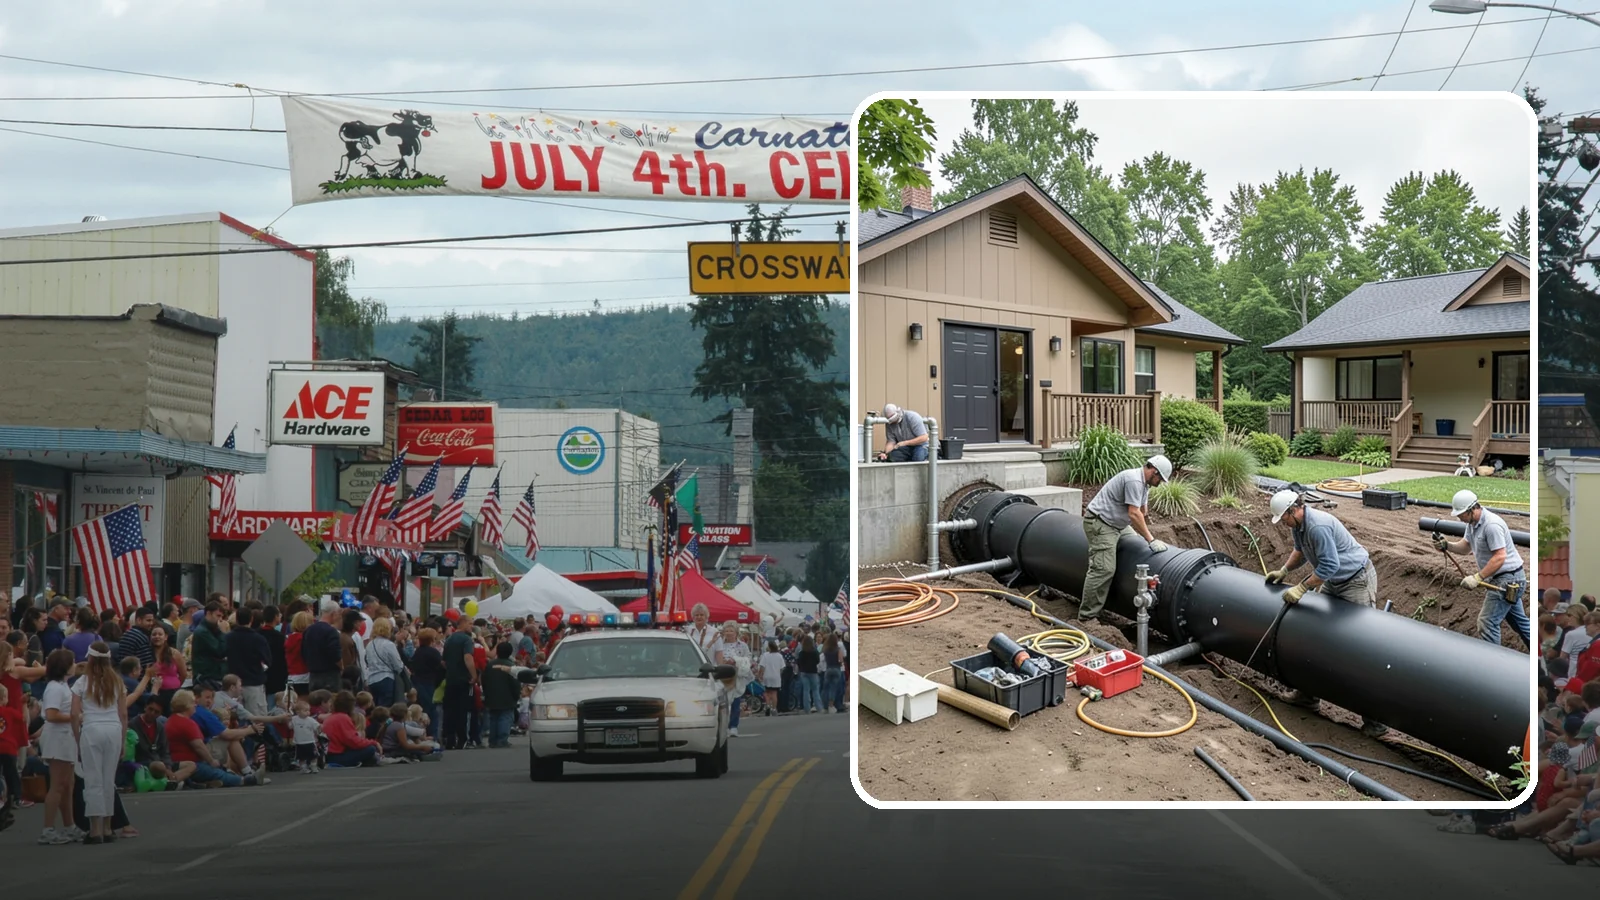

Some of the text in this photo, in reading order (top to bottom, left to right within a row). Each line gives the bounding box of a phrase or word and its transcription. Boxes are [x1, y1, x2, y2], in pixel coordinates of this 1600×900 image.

[481, 141, 605, 192] JULY
[632, 150, 746, 198] 4th.
[697, 254, 850, 280] CROSSWA
[283, 380, 373, 420] ACE
[405, 409, 453, 422] CEDAR
[283, 421, 371, 436] Hardware
[416, 428, 477, 447] Coca-Cola
[83, 485, 155, 495] St. Vincent de Paul
[688, 526, 741, 535] CRNATION
[699, 535, 730, 543] GLASS
